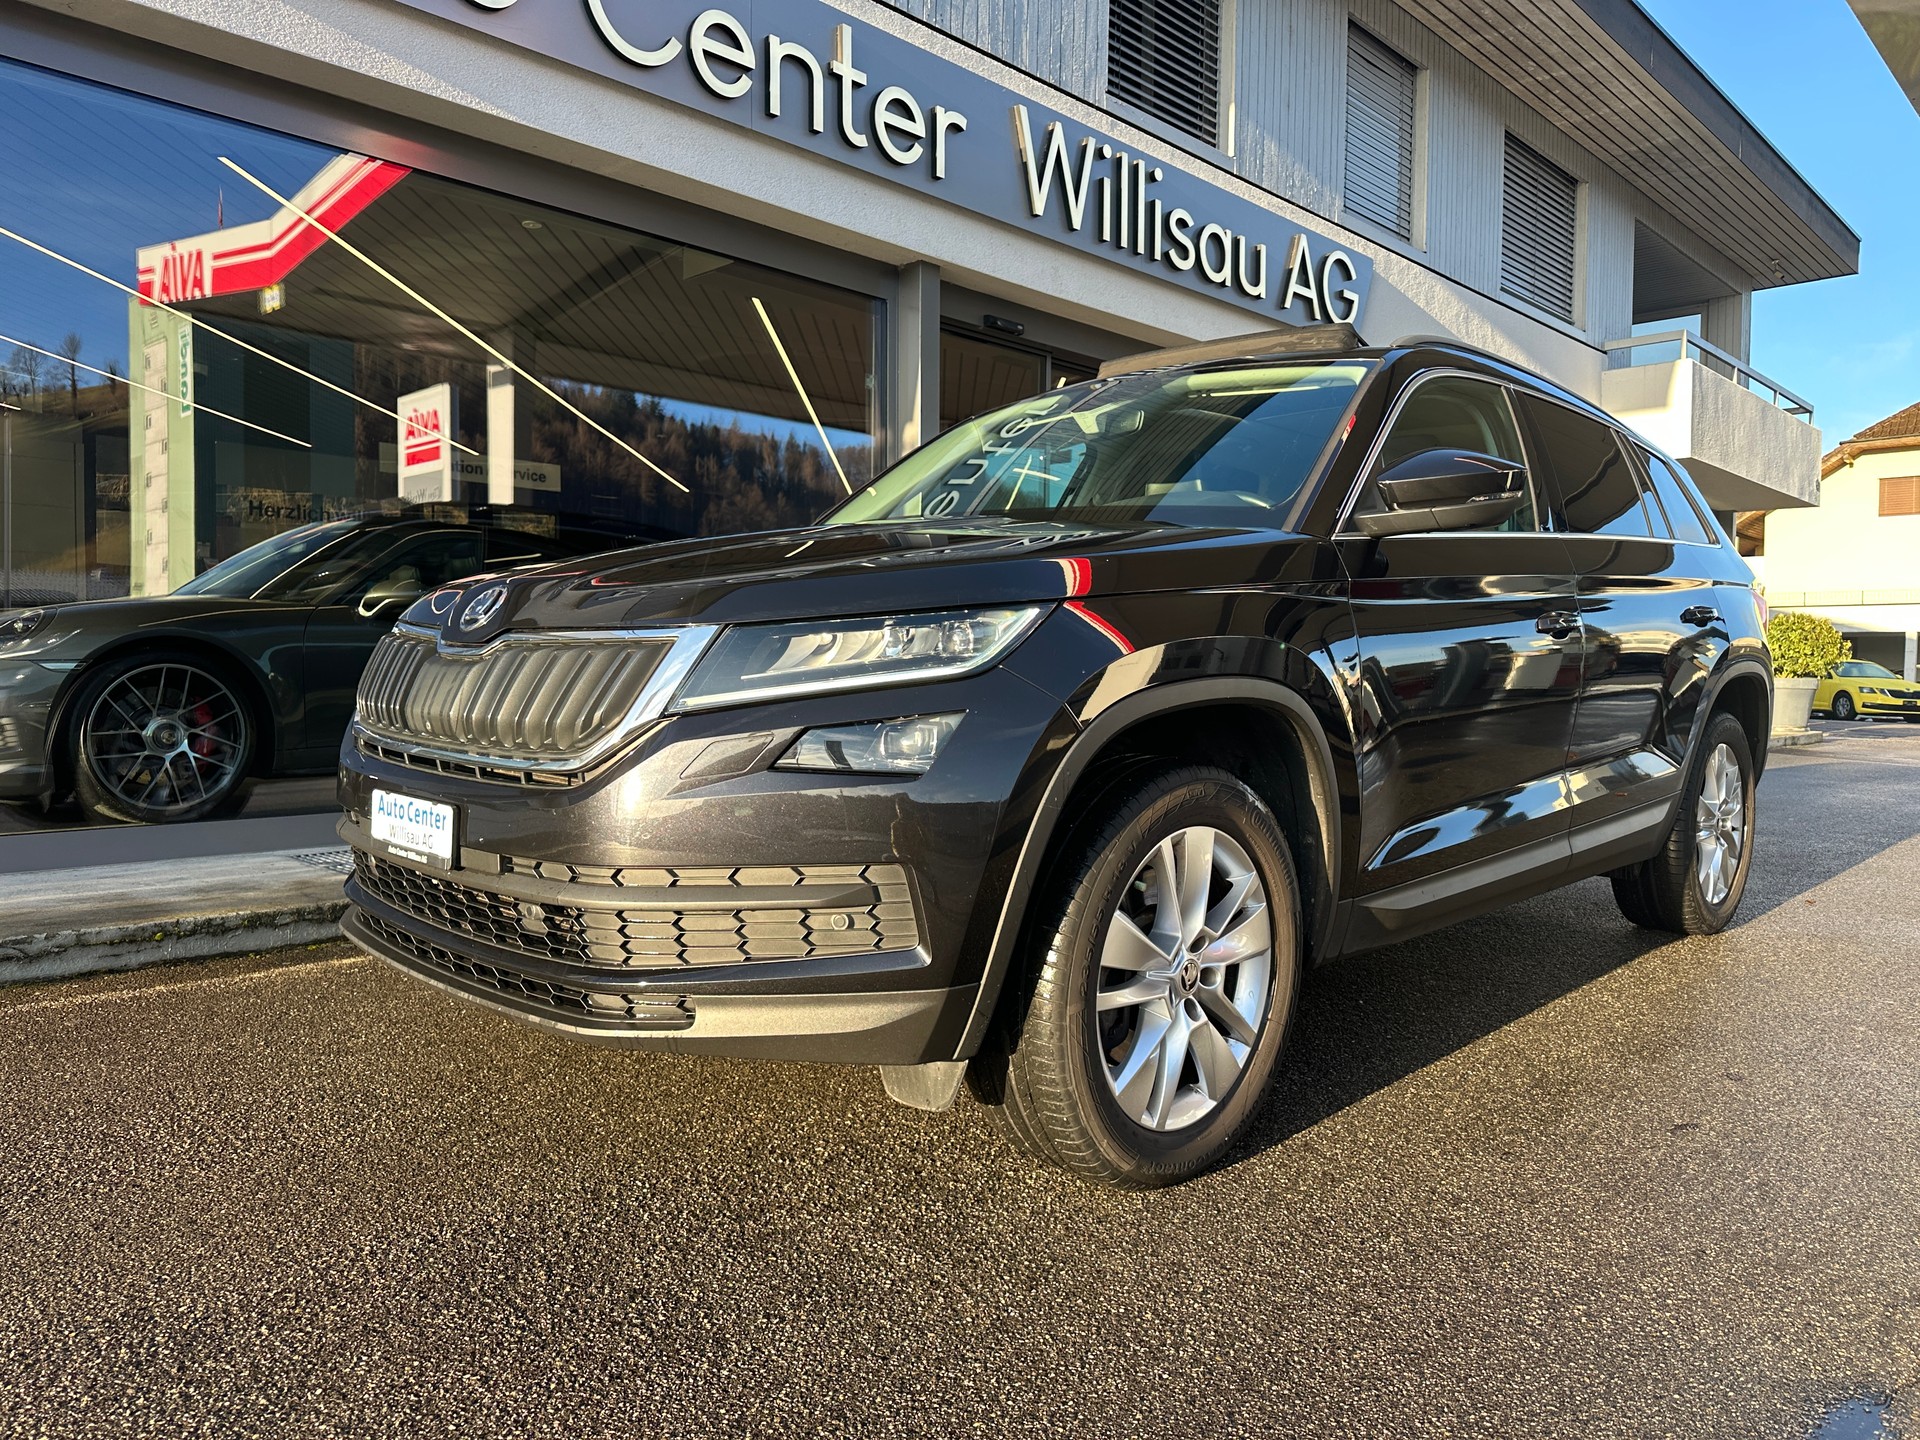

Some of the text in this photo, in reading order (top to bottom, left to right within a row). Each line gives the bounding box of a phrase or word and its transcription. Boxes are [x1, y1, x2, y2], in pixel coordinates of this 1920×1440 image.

[1010, 104, 1267, 299] Willisau
[1281, 233, 1359, 324] AG
[514, 468, 547, 483] rvice
[249, 499, 330, 523] Herzlich
[389, 824, 433, 850] Willisau AG
